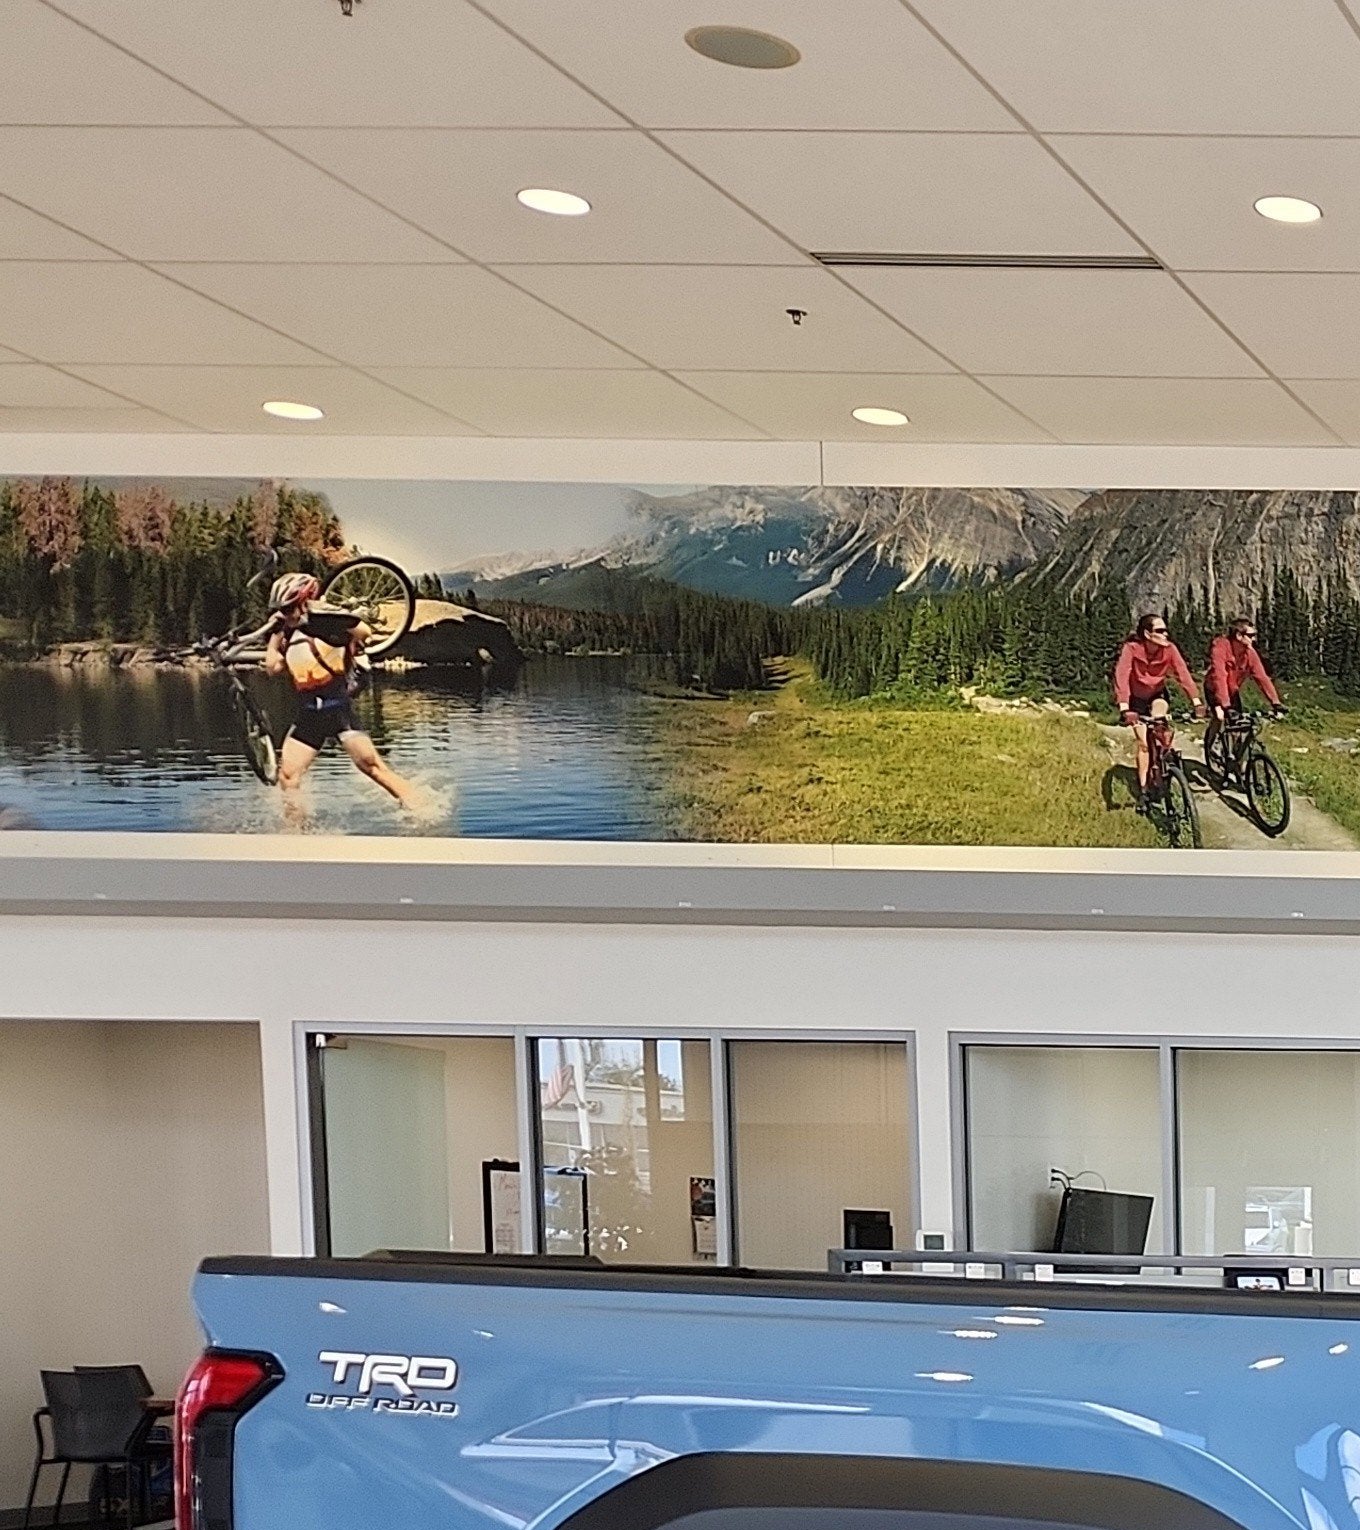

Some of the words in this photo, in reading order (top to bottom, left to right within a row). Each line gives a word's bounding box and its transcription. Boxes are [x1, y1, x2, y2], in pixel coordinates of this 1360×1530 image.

[318, 1350, 459, 1397] TRD
[306, 1392, 369, 1410] OFF
[372, 1397, 459, 1417] ROAD
